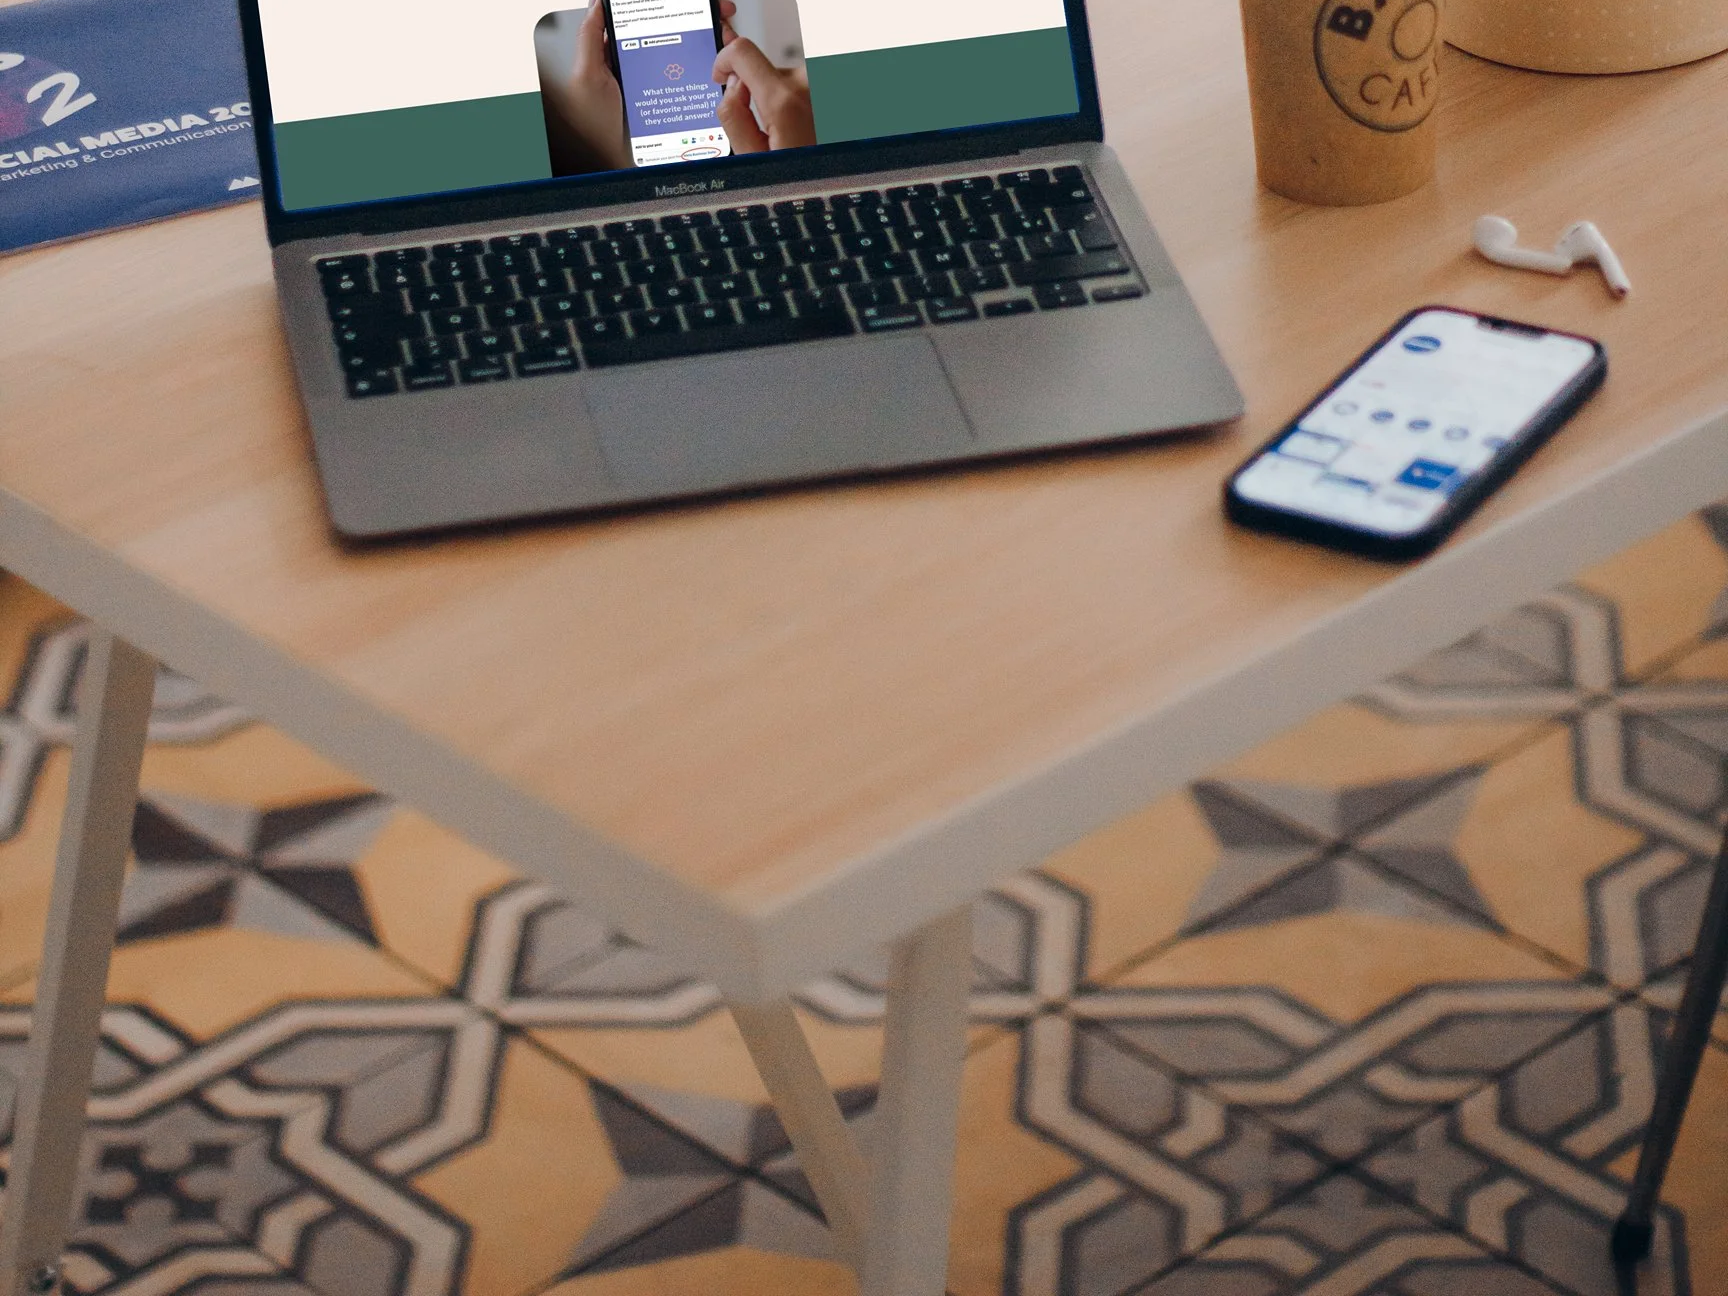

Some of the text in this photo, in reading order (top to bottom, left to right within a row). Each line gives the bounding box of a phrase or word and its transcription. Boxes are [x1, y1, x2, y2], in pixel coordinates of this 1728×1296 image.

[643, 83, 709, 97] What three things
[1360, 58, 1440, 111] CAF
[635, 98, 658, 107] would
[659, 98, 673, 106] you
[688, 93, 705, 101] your
[706, 91, 719, 99] pet
[652, 105, 682, 115] favorite
[645, 111, 714, 126] they could answer?
[80, 114, 209, 151] MEDIA
[655, 179, 725, 197] MacBook Air
